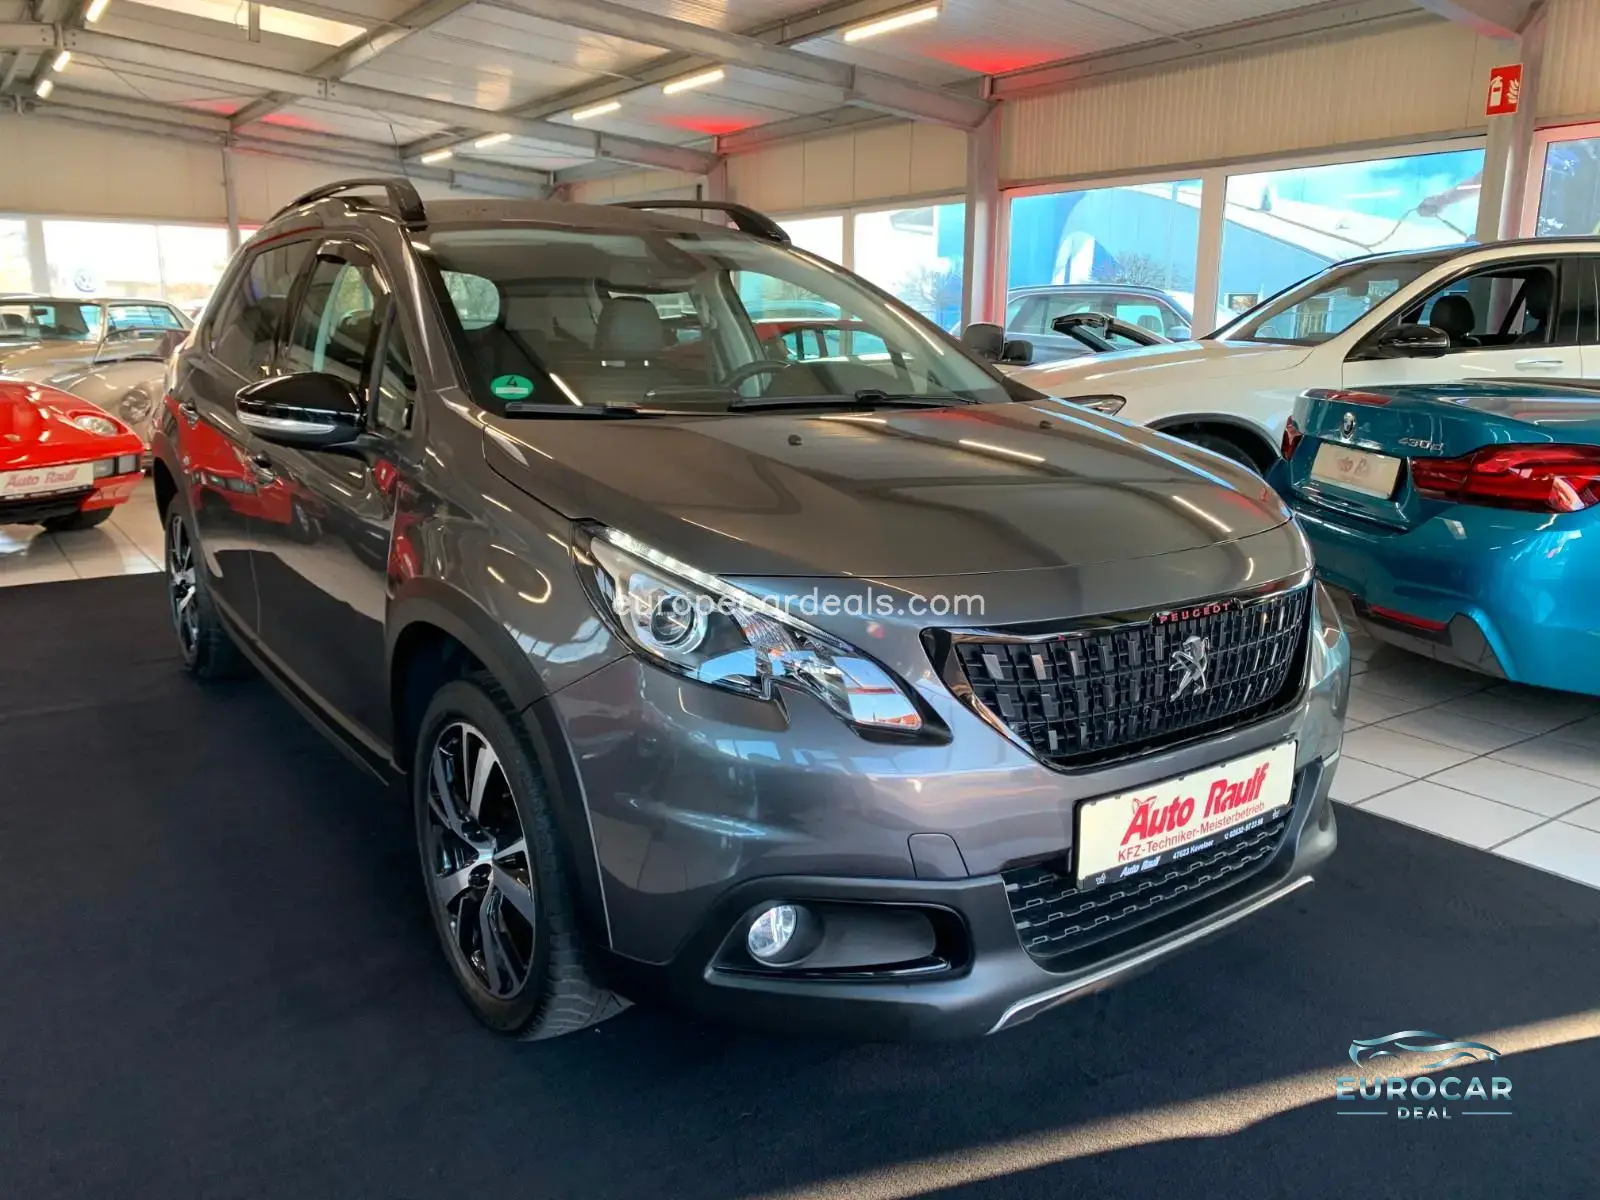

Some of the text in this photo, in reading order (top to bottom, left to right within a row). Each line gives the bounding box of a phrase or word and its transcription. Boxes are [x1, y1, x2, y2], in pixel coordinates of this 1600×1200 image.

[5, 474, 40, 488] Auto
[1159, 601, 1231, 624] PEUGEOT
[1117, 802, 1264, 862] KFZ-Techniker-Meisterbetrieb
[1120, 796, 1195, 846] Auto
